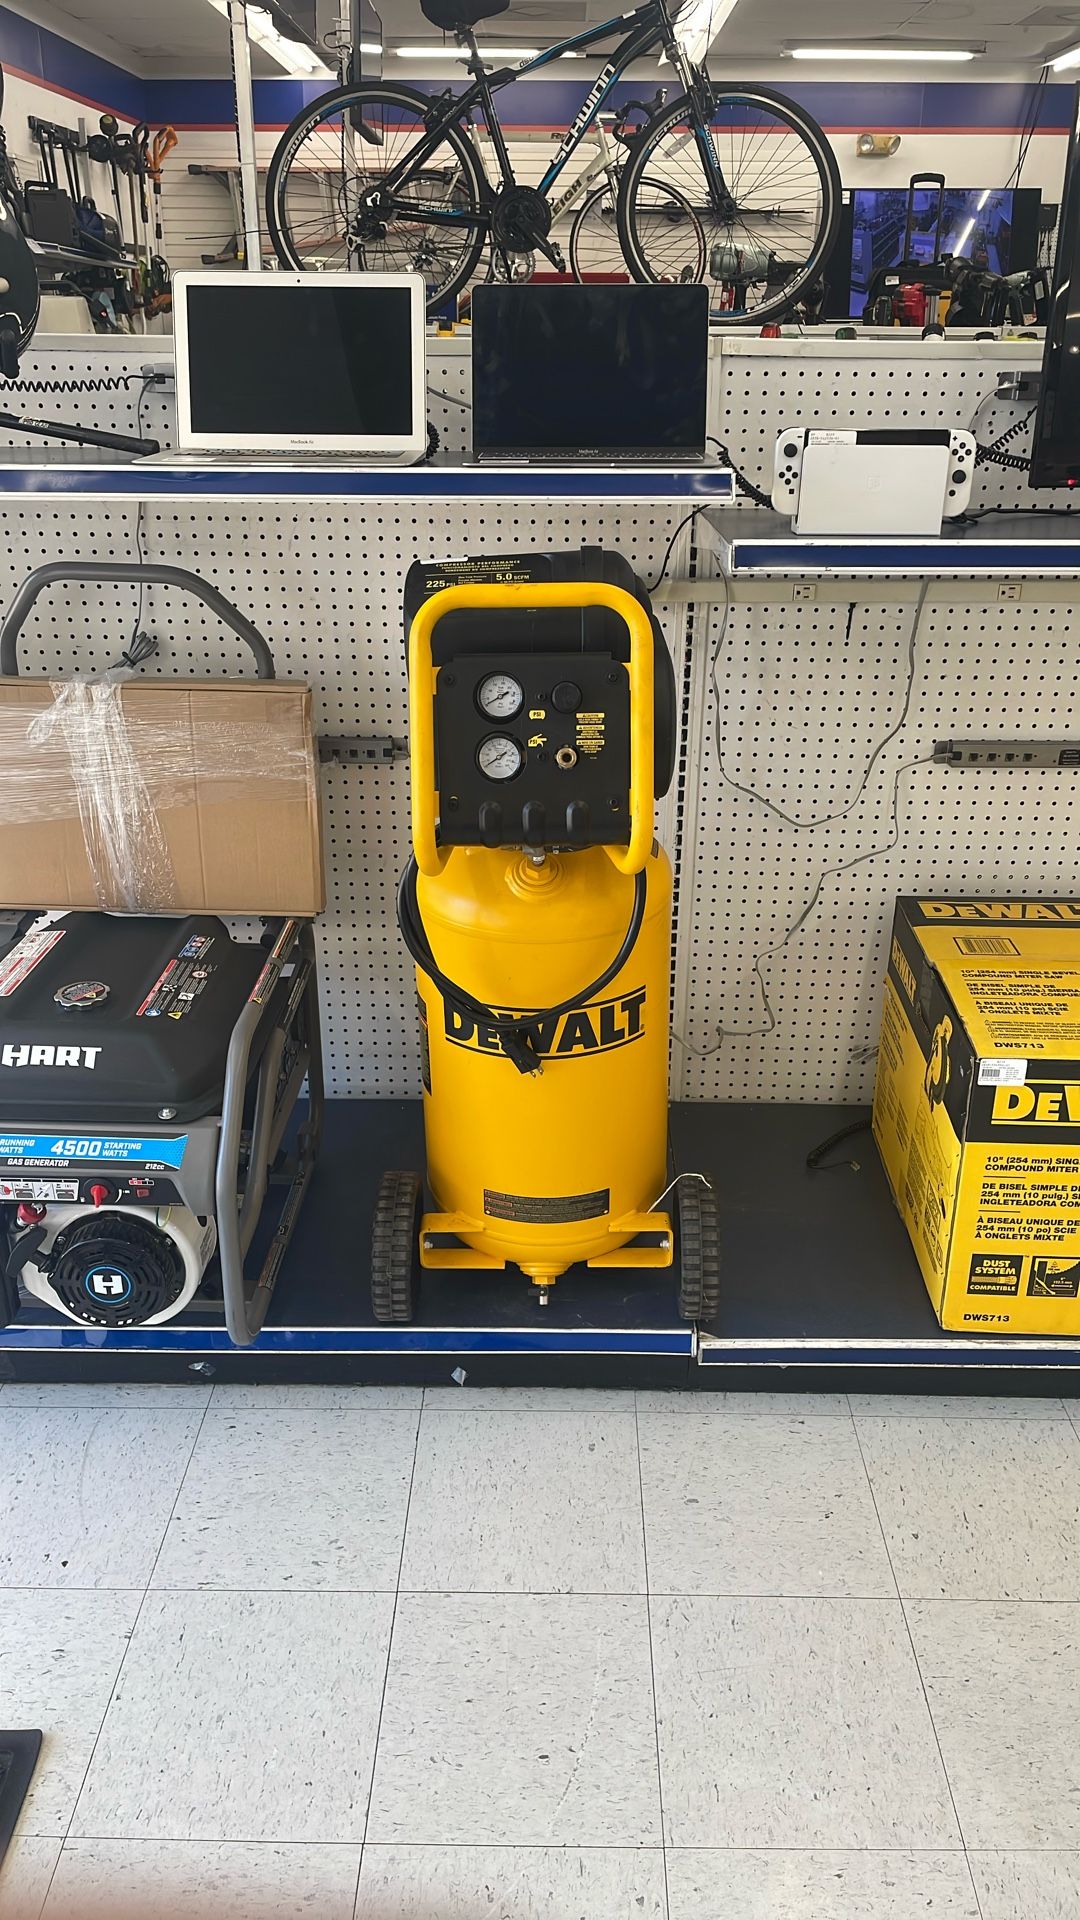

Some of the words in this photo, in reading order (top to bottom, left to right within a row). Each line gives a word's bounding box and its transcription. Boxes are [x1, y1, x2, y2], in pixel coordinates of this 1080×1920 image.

[553, 63, 616, 165] SCHWINN
[281, 115, 320, 182] SCHWINN
[704, 124, 719, 168] SCHWINN
[551, 179, 582, 216] EIGH
[918, 903, 1080, 919] DEWAL
[2, 1044, 102, 1070] HART
[0, 1139, 35, 1147] RUNNING
[51, 1140, 101, 1156] 4500
[24, 1159, 69, 1167] GENERATOR
[93, 1275, 123, 1295] H
